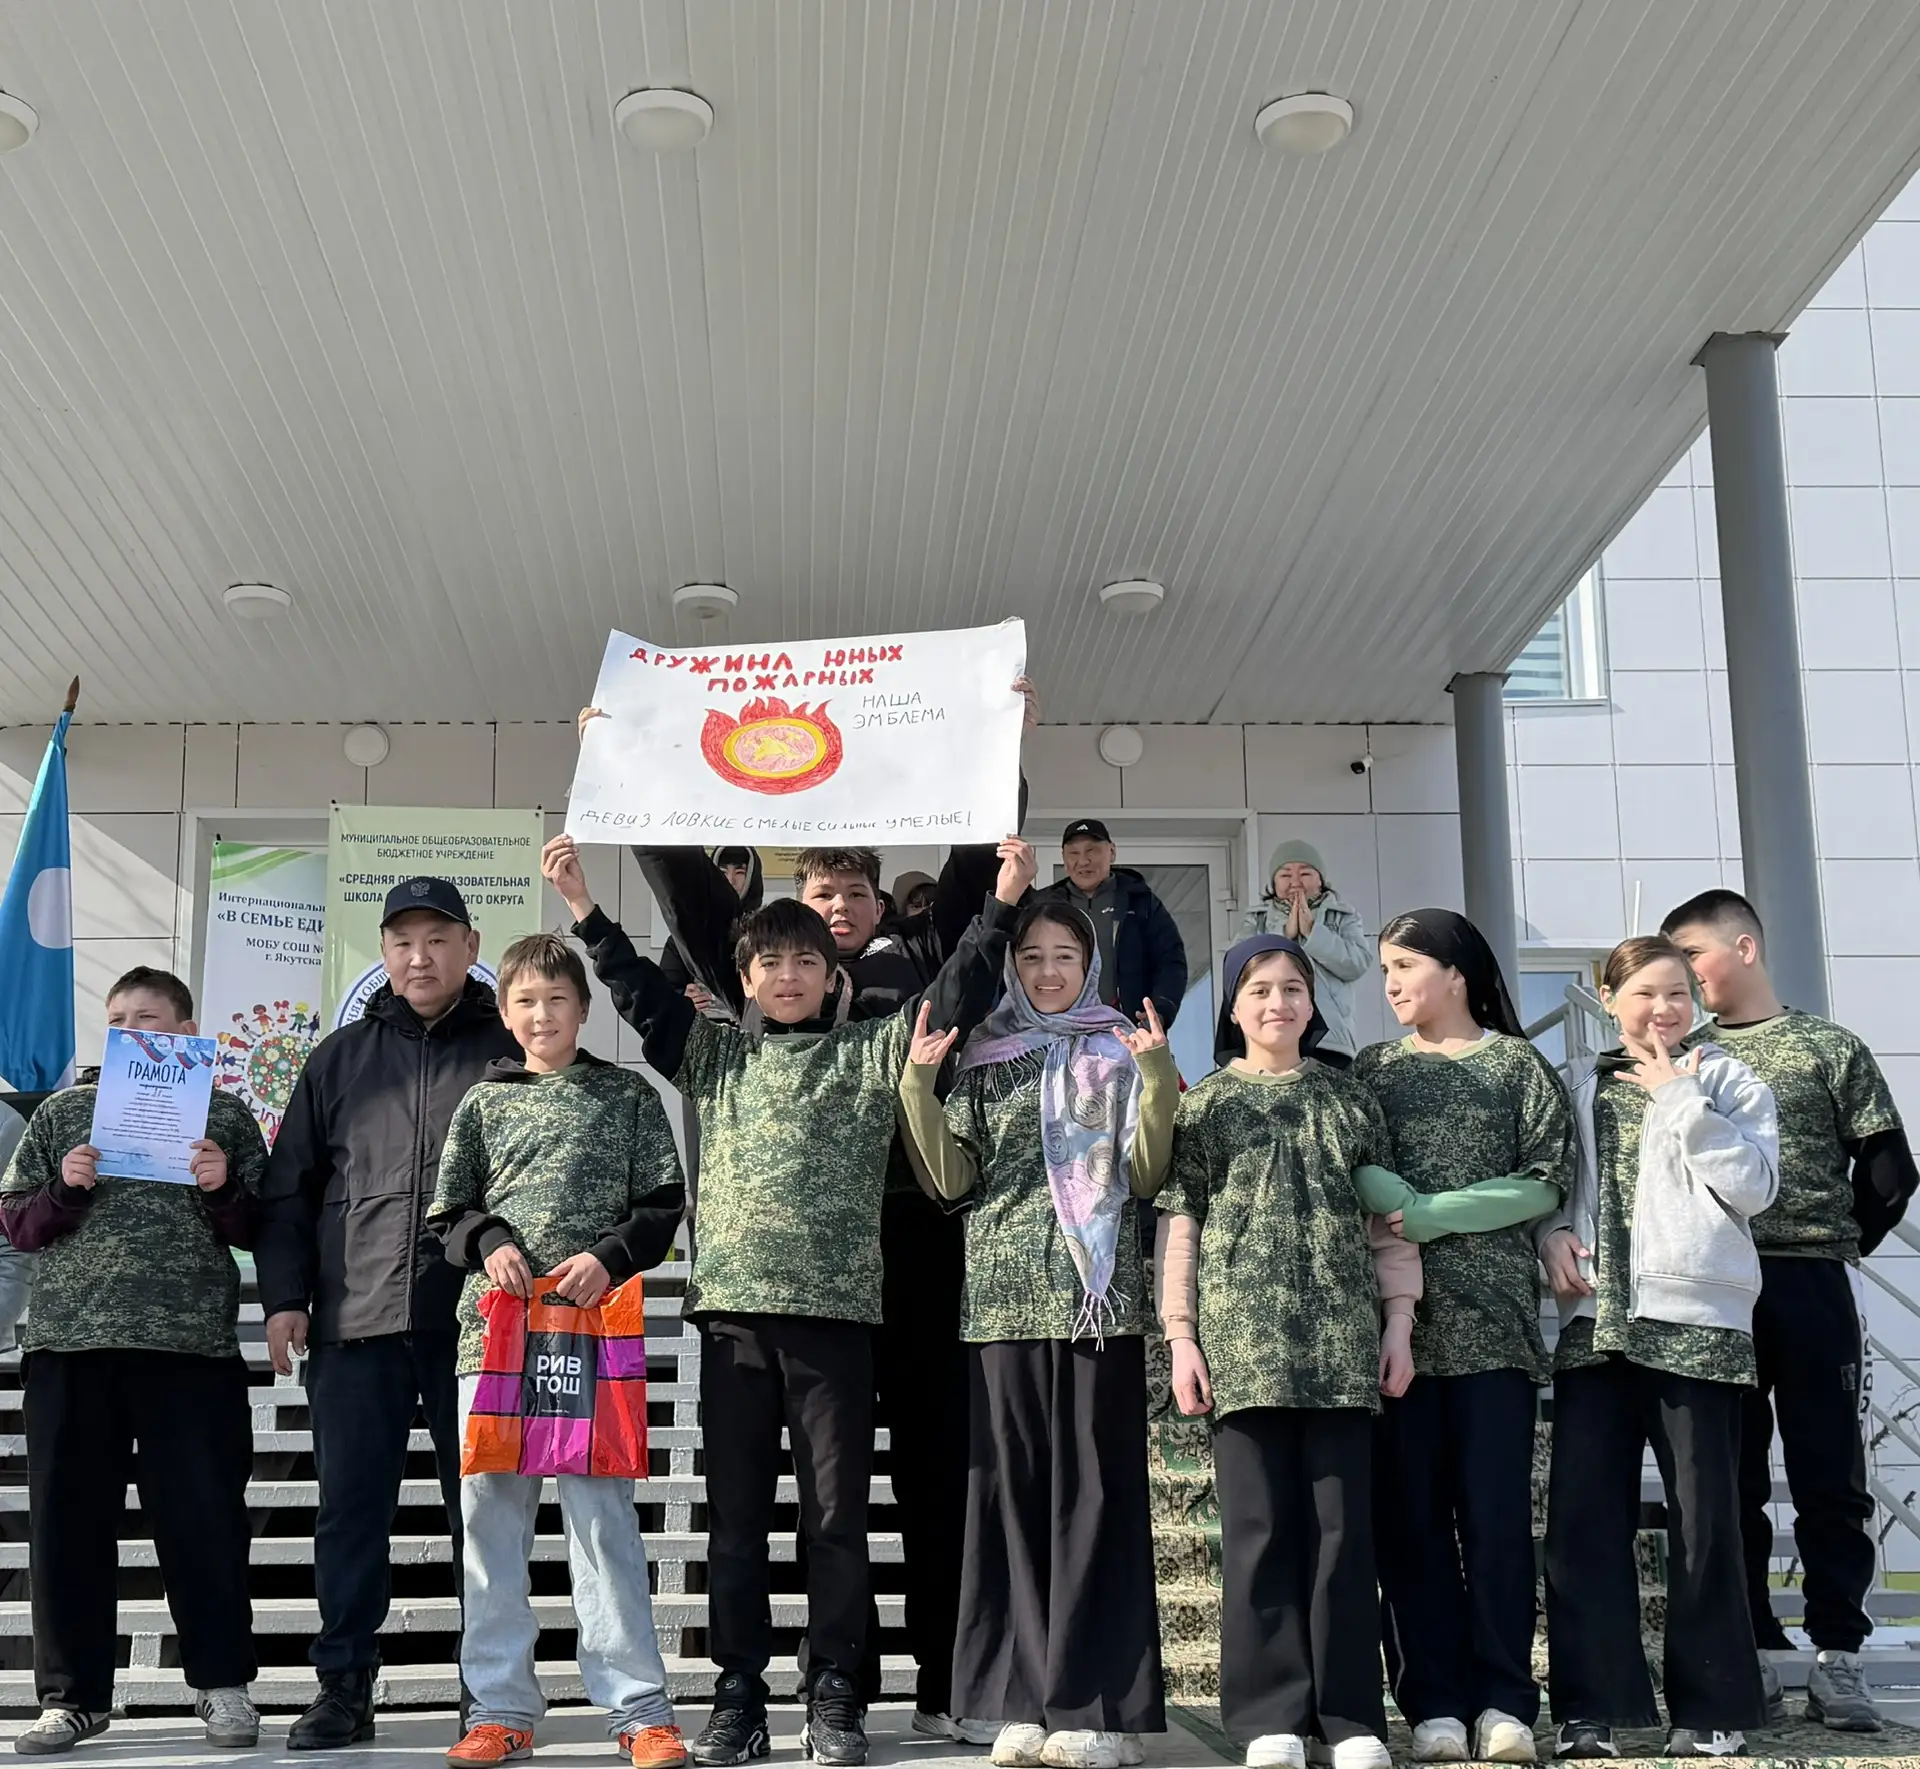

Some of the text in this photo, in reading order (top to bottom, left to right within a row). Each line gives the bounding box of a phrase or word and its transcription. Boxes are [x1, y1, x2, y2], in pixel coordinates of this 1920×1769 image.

[629, 644, 904, 674] ДРУЖИНА ЮНЫХ
[707, 668, 874, 692] ПОЖАРНЫХ
[862, 691, 922, 708] НАША
[852, 707, 945, 729] ЭМБЛЕМА
[580, 810, 651, 828] ДЕВИЗ
[661, 811, 738, 829] ЛОВКИЕ
[886, 811, 972, 829] УМЕЛЫЕ!
[341, 833, 531, 847] МУНИЦИПАЛЬНОЕ ОБЩЕОБРАЗОВАТЕЛЬНОЕ
[377, 848, 495, 860] БЮДЖЕТНОЕ УЧРЕЖДЕНИЕ
[339, 873, 531, 888] «СРЕДНЯЯ ОРАЗОВАТЕЛЬНАЯ
[344, 891, 383, 902] ШКОЛА
[486, 894, 525, 905] ОКРУГА
[217, 909, 237, 922] «В
[240, 911, 294, 929] СЕМЬЕ
[246, 938, 280, 950] МОБУ
[282, 941, 310, 953] СОШ
[265, 953, 322, 966] г. Якутска
[128, 1060, 186, 1085] ГРАМОТА
[536, 1354, 582, 1375] РИВ
[536, 1375, 580, 1395] ГОШ
